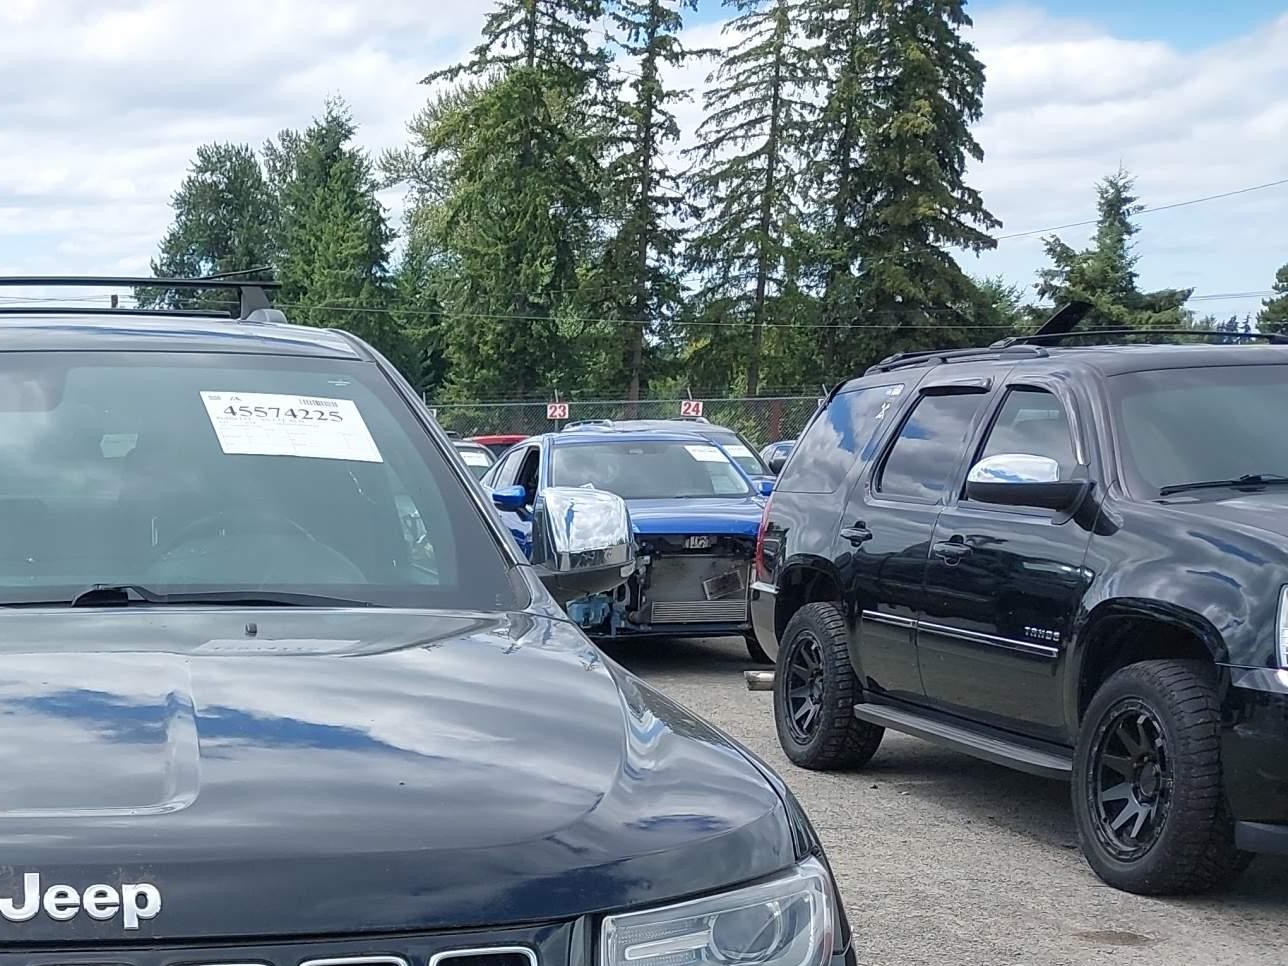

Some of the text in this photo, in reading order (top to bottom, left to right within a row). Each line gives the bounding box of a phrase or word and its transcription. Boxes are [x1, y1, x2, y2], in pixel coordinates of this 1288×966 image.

[223, 405, 343, 423] 45574225
[548, 404, 567, 418] 23
[682, 401, 701, 415] 24
